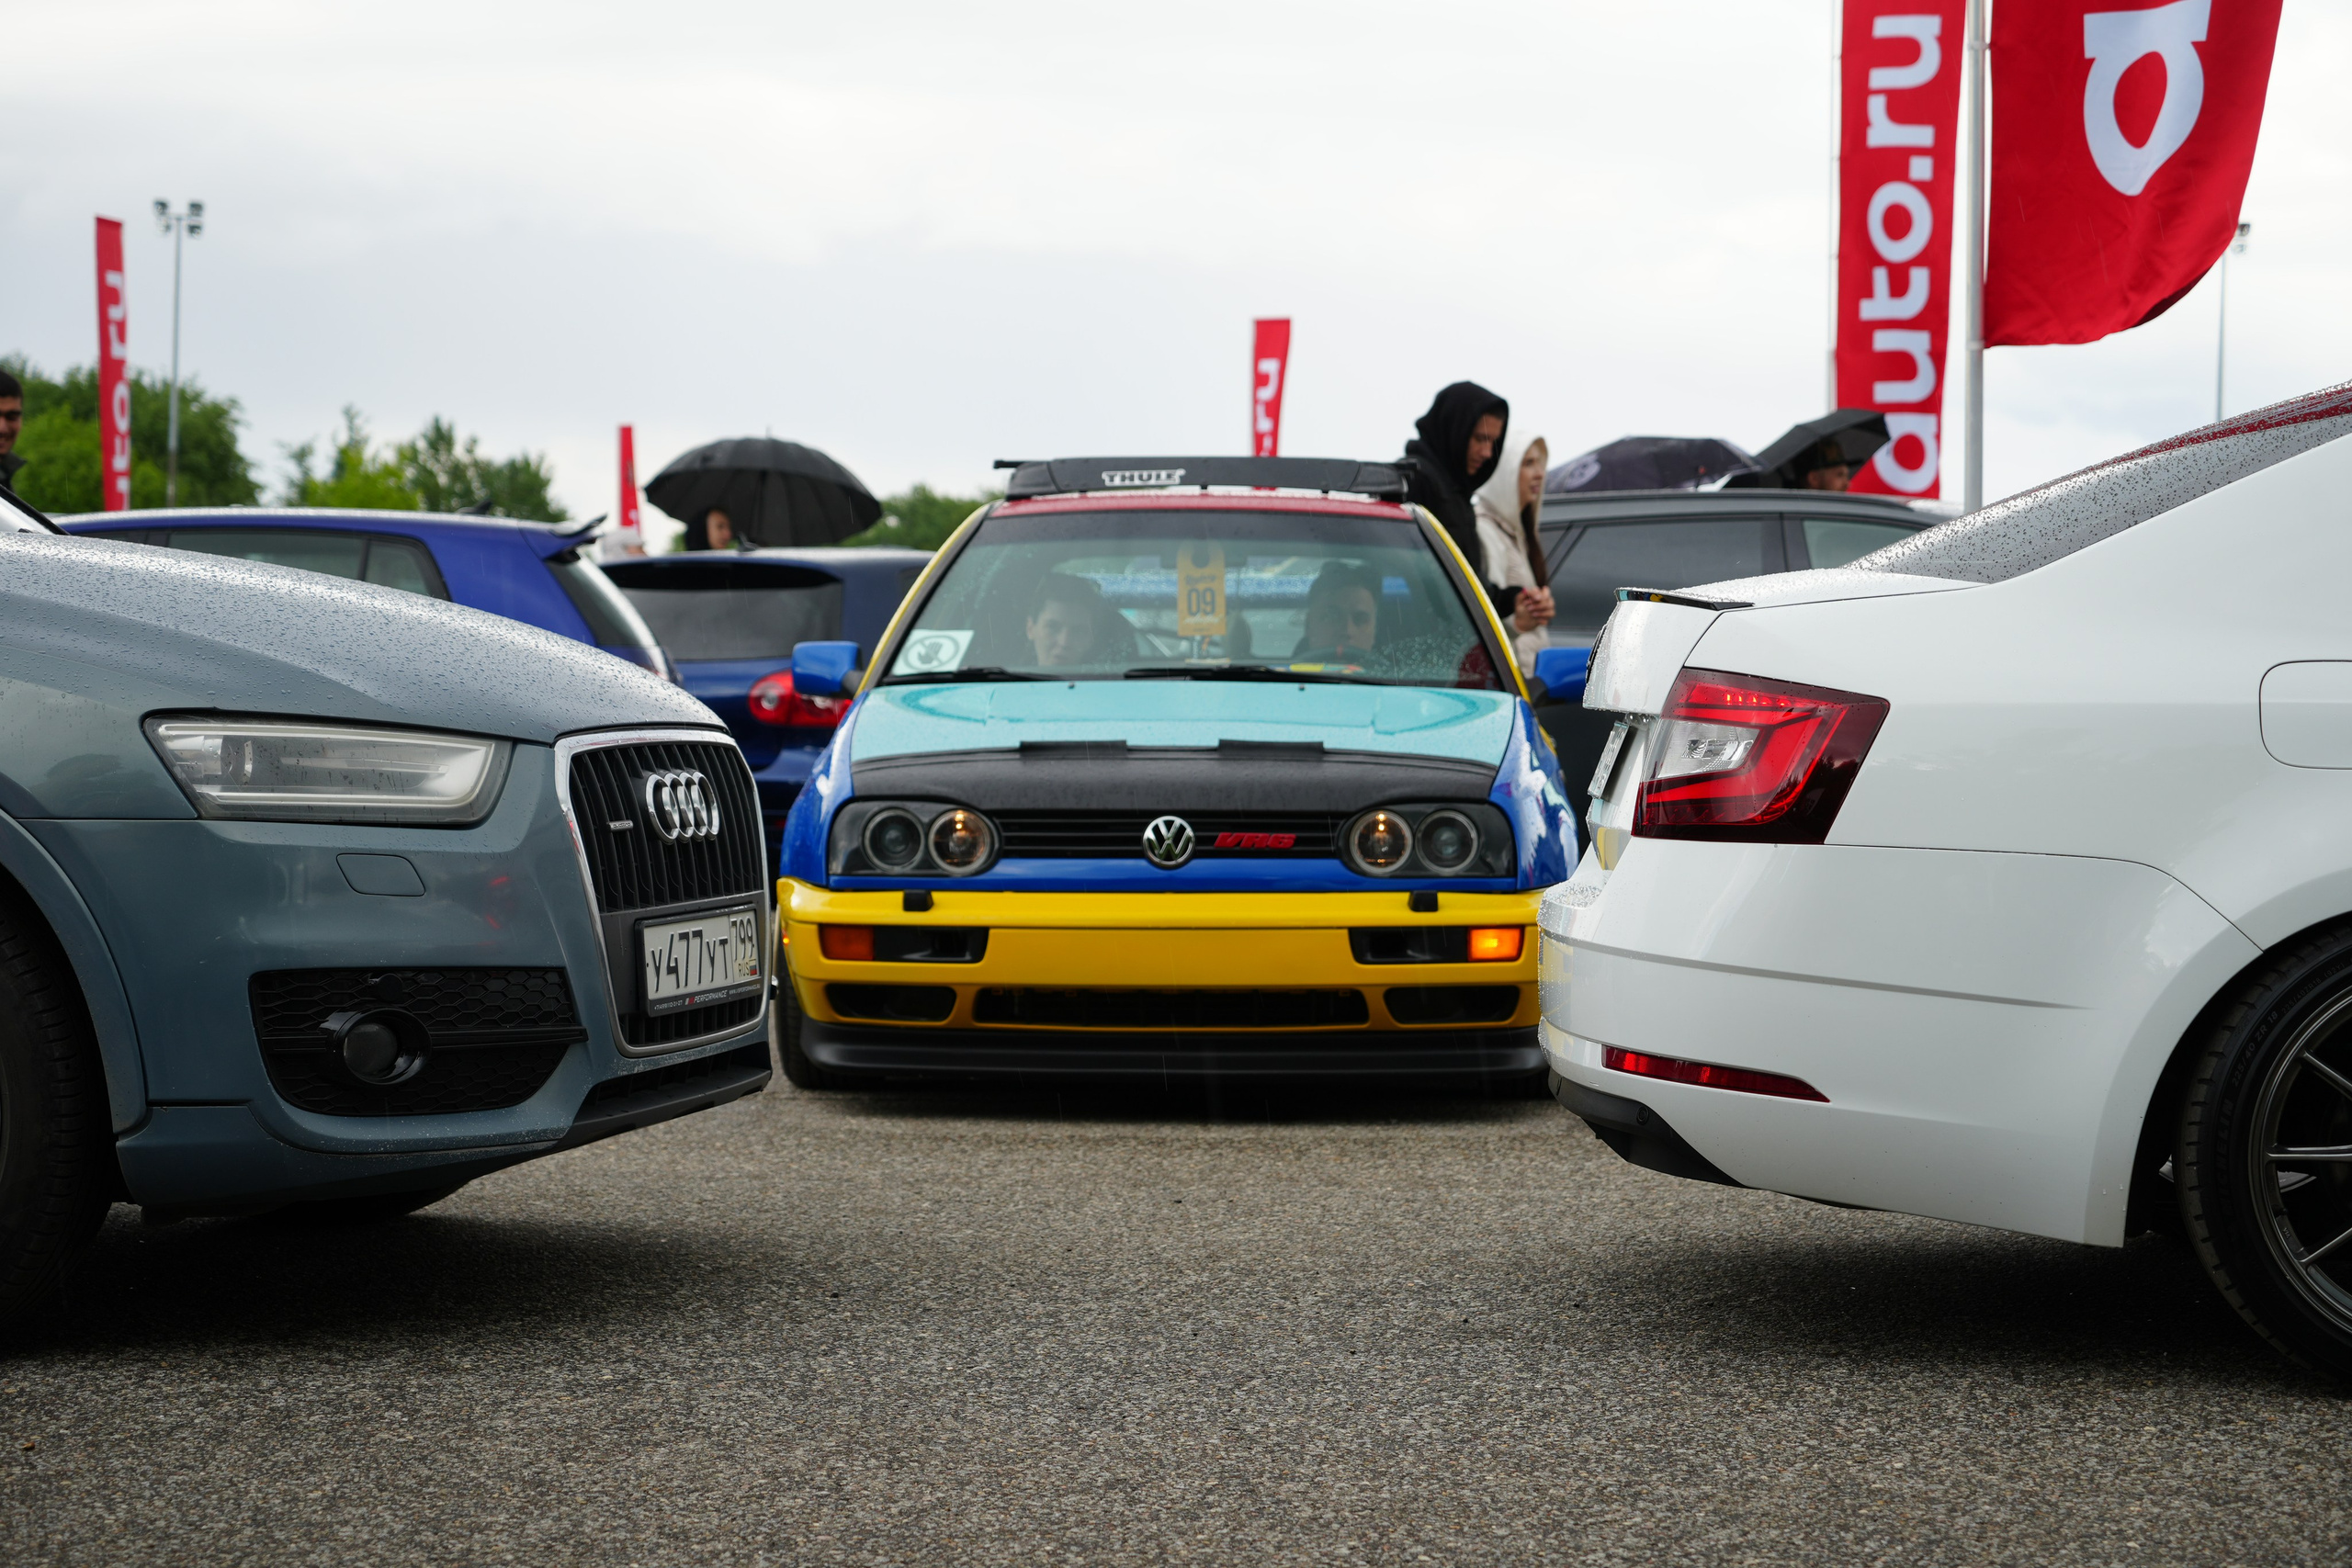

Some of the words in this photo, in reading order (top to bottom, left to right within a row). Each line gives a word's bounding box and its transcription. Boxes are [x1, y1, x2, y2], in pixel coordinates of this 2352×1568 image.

[1859, 13, 1942, 494] auto.ru
[1102, 468, 1183, 487] THULE
[1187, 587, 1216, 616] 09
[1213, 832, 1297, 849] VR6
[730, 916, 753, 962] 799
[738, 962, 750, 976] RUS
[694, 989, 729, 1004] PERFORMANCE
